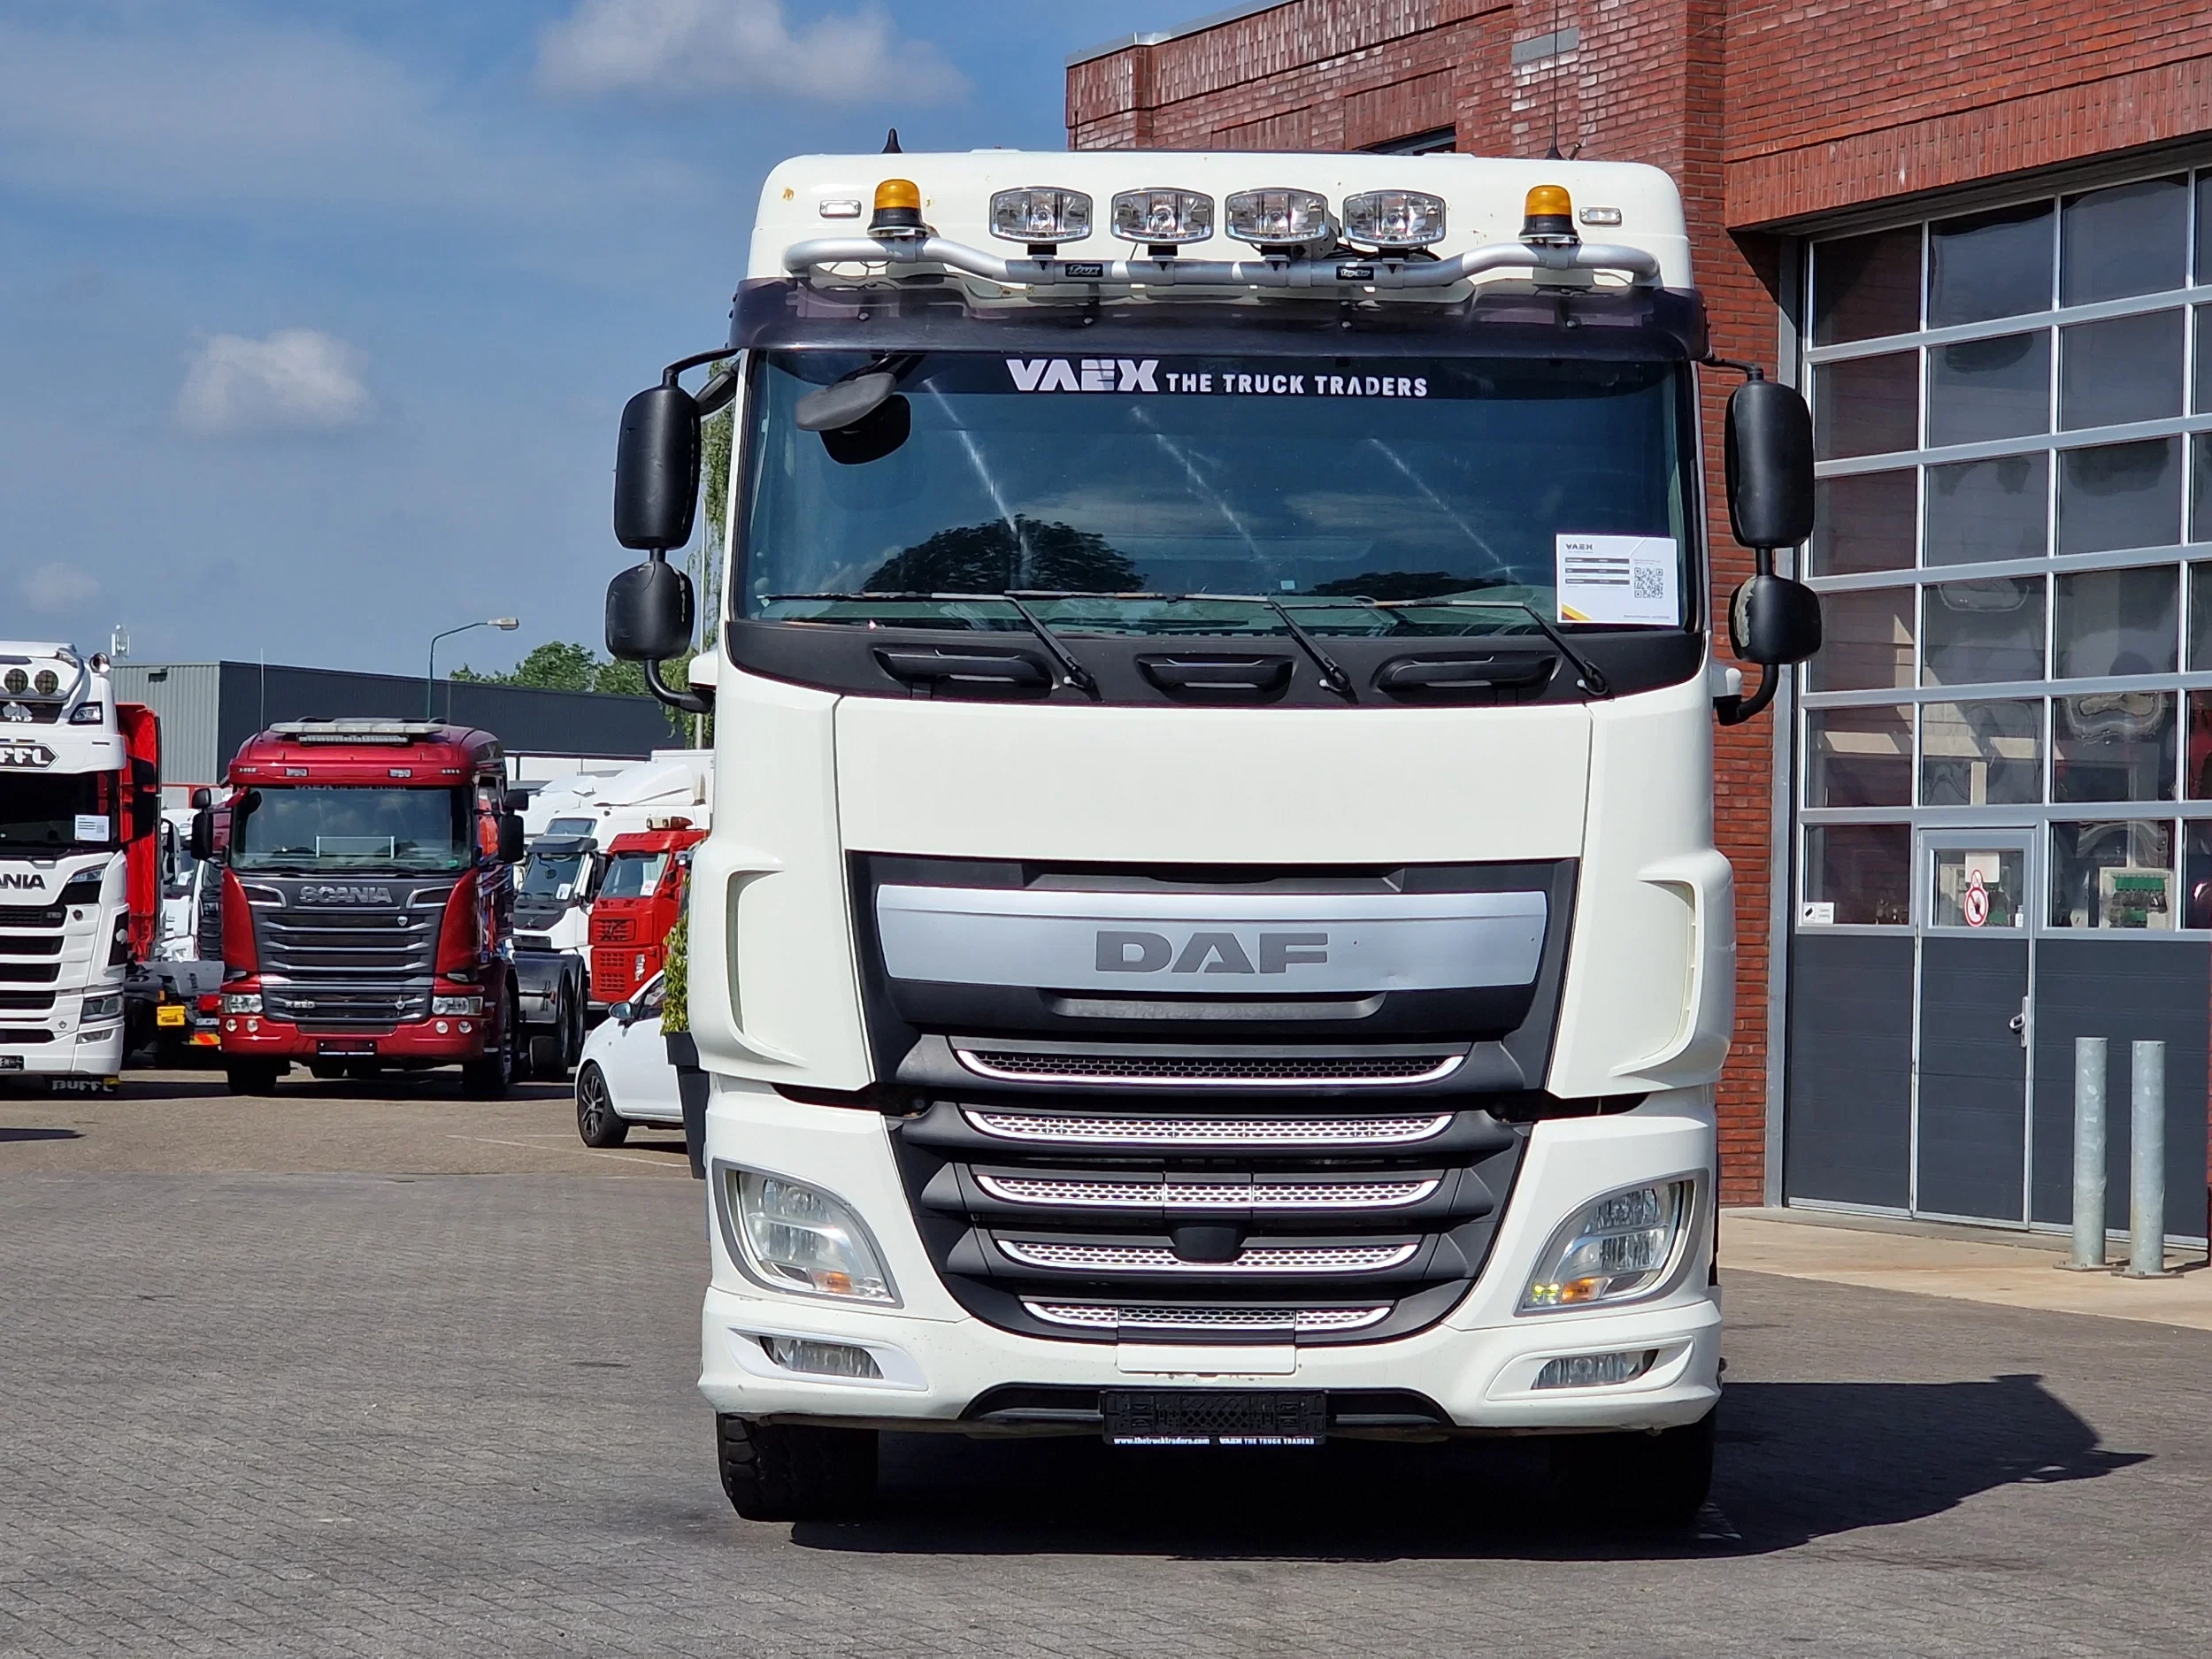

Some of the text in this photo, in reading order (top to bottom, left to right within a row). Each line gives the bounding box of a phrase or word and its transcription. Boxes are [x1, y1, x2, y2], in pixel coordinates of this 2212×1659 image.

[1006, 359, 1428, 396] VAEX THE TRUCK TRADERS
[299, 886, 393, 903] SCANIA
[1096, 931, 1327, 973] DAF
